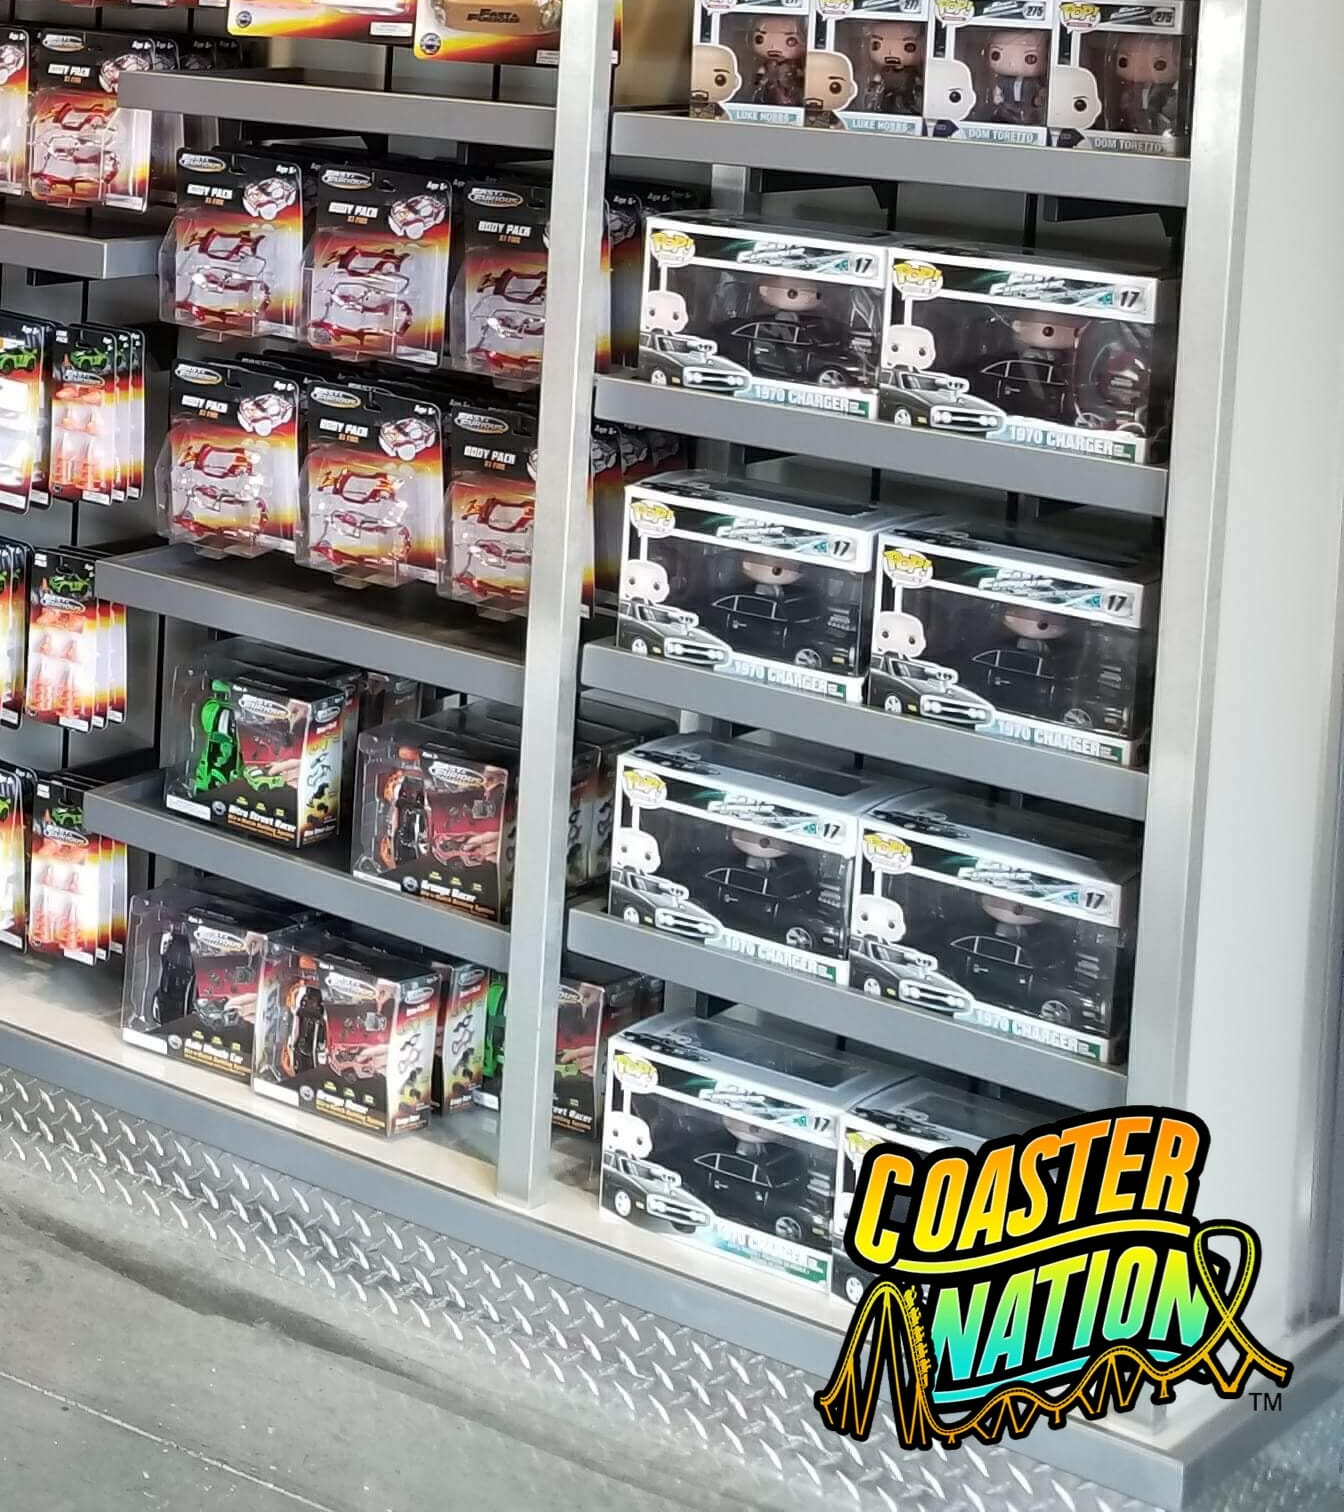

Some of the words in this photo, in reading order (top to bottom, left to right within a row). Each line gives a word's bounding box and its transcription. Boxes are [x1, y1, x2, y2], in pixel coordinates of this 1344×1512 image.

[903, 0, 919, 11] 277
[1026, 6, 1043, 17] 275
[736, 111, 756, 122] LUKE
[853, 119, 872, 129] LUKE
[968, 129, 988, 141] DOM
[990, 130, 1035, 143] TORETTO
[1094, 138, 1118, 150] DOM
[1120, 139, 1163, 153] TORETTO
[478, 221, 504, 234] BODY
[506, 224, 531, 237] PACK
[854, 257, 873, 274] 17
[1120, 290, 1140, 307] 17
[787, 390, 850, 412] CHARGER
[1046, 430, 1113, 455] CHARGER
[464, 446, 489, 460] BODY
[491, 450, 516, 465] PACK
[832, 539, 851, 556] 17
[1106, 594, 1126, 612] 17
[767, 667, 828, 694] CHARGER
[1034, 729, 1100, 756] CHARGER
[822, 822, 840, 839] 17
[1085, 892, 1105, 908] 17
